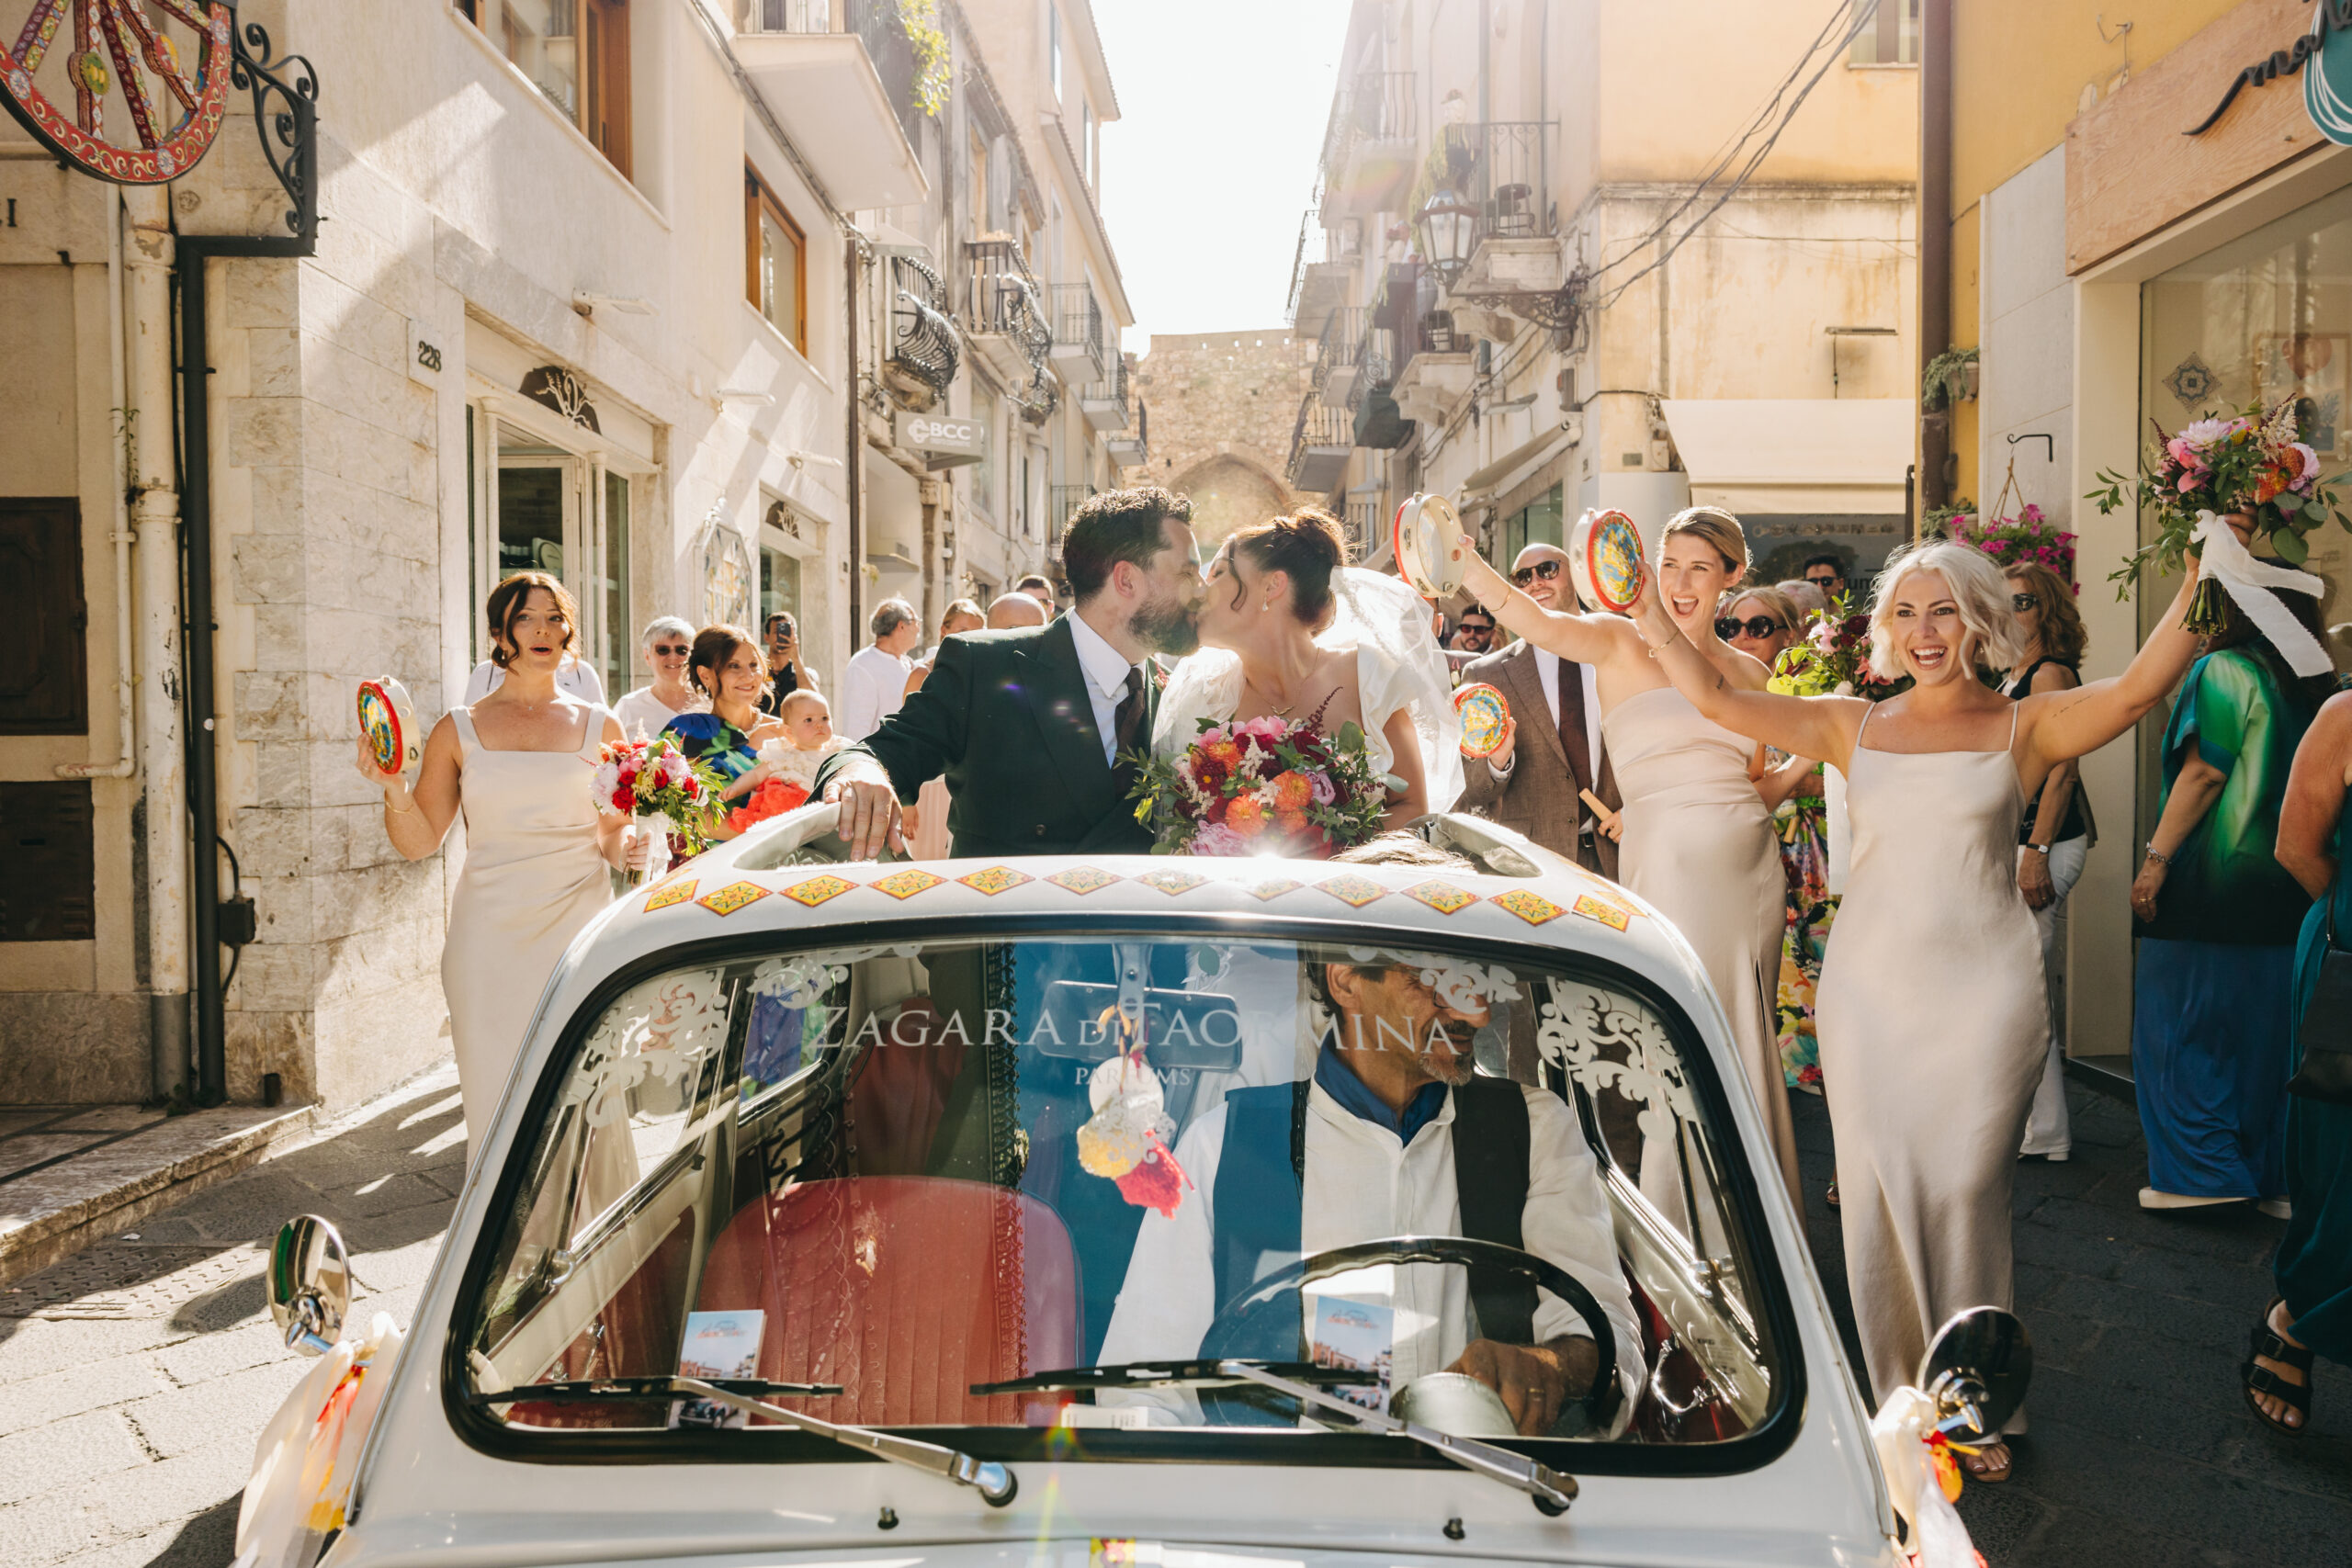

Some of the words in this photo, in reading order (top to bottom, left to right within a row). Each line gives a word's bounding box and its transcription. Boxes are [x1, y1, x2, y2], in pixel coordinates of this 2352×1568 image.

[418, 340, 442, 373] 228
[930, 422, 970, 440] BCC
[807, 1007, 1066, 1047] ZAGARA
[1078, 1020, 1125, 1046] DI
[1122, 1002, 1462, 1055] TAORMINA
